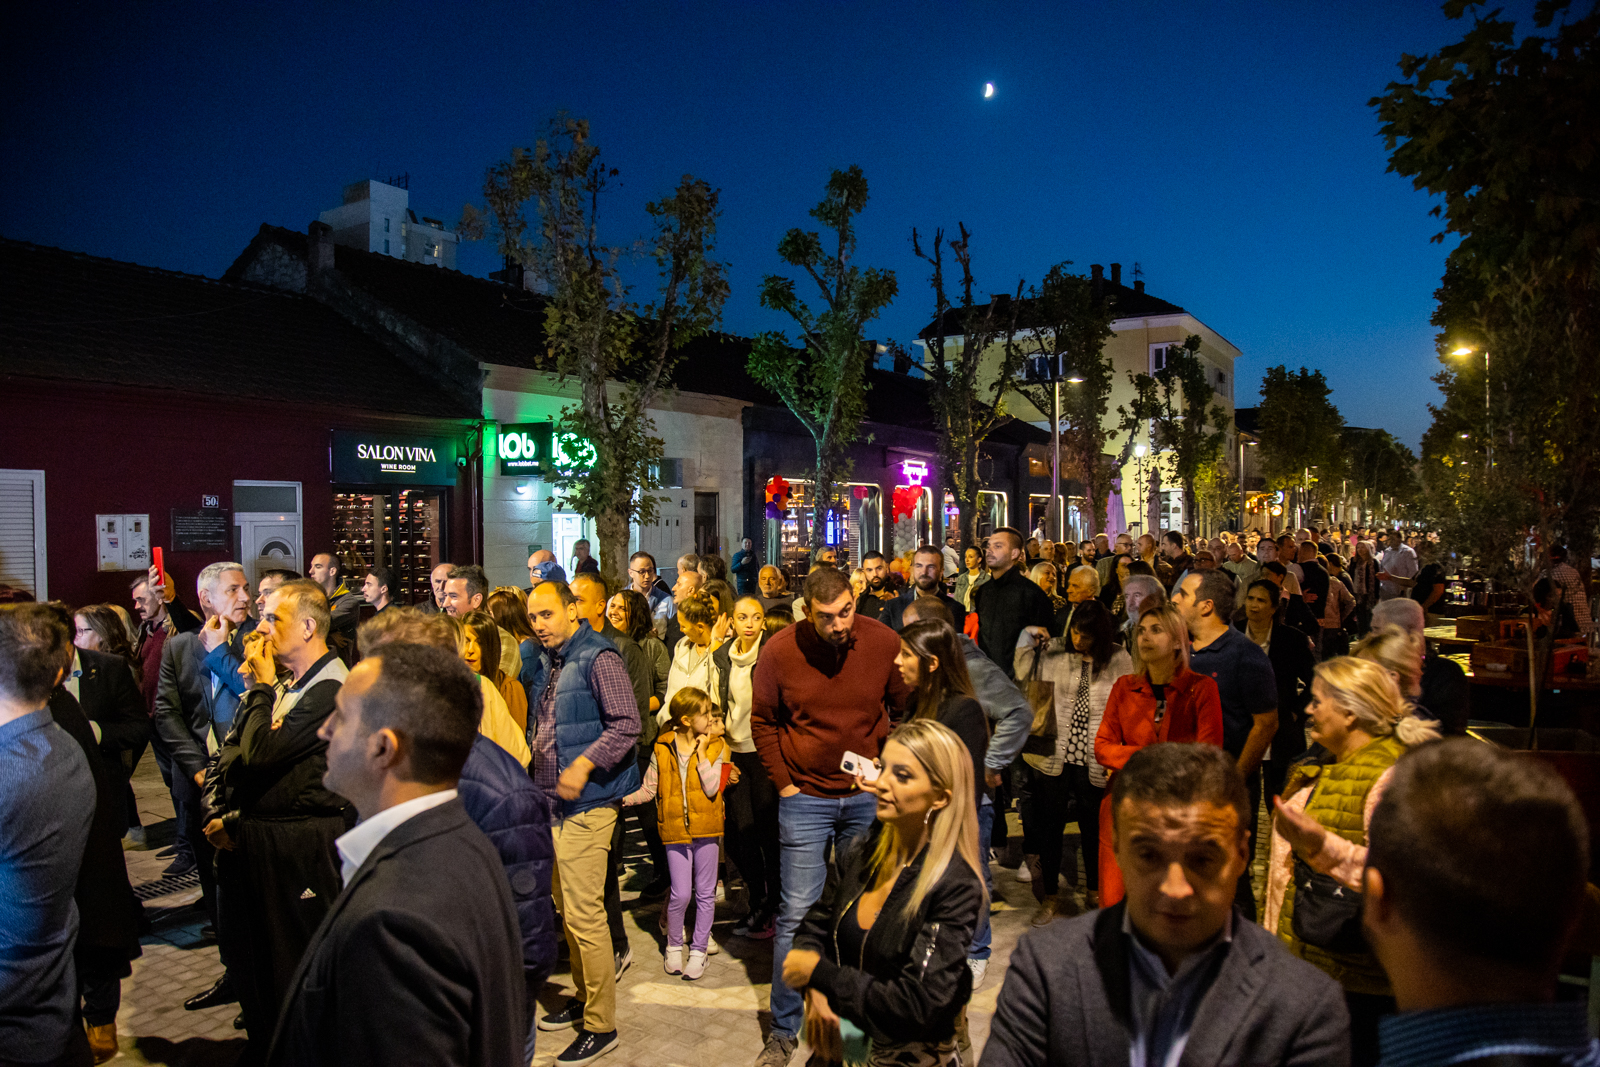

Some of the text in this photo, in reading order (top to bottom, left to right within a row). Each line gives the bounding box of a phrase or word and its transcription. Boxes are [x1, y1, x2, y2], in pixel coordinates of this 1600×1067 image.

[357, 444, 437, 462] SALON VINA
[205, 496, 217, 506] 50
